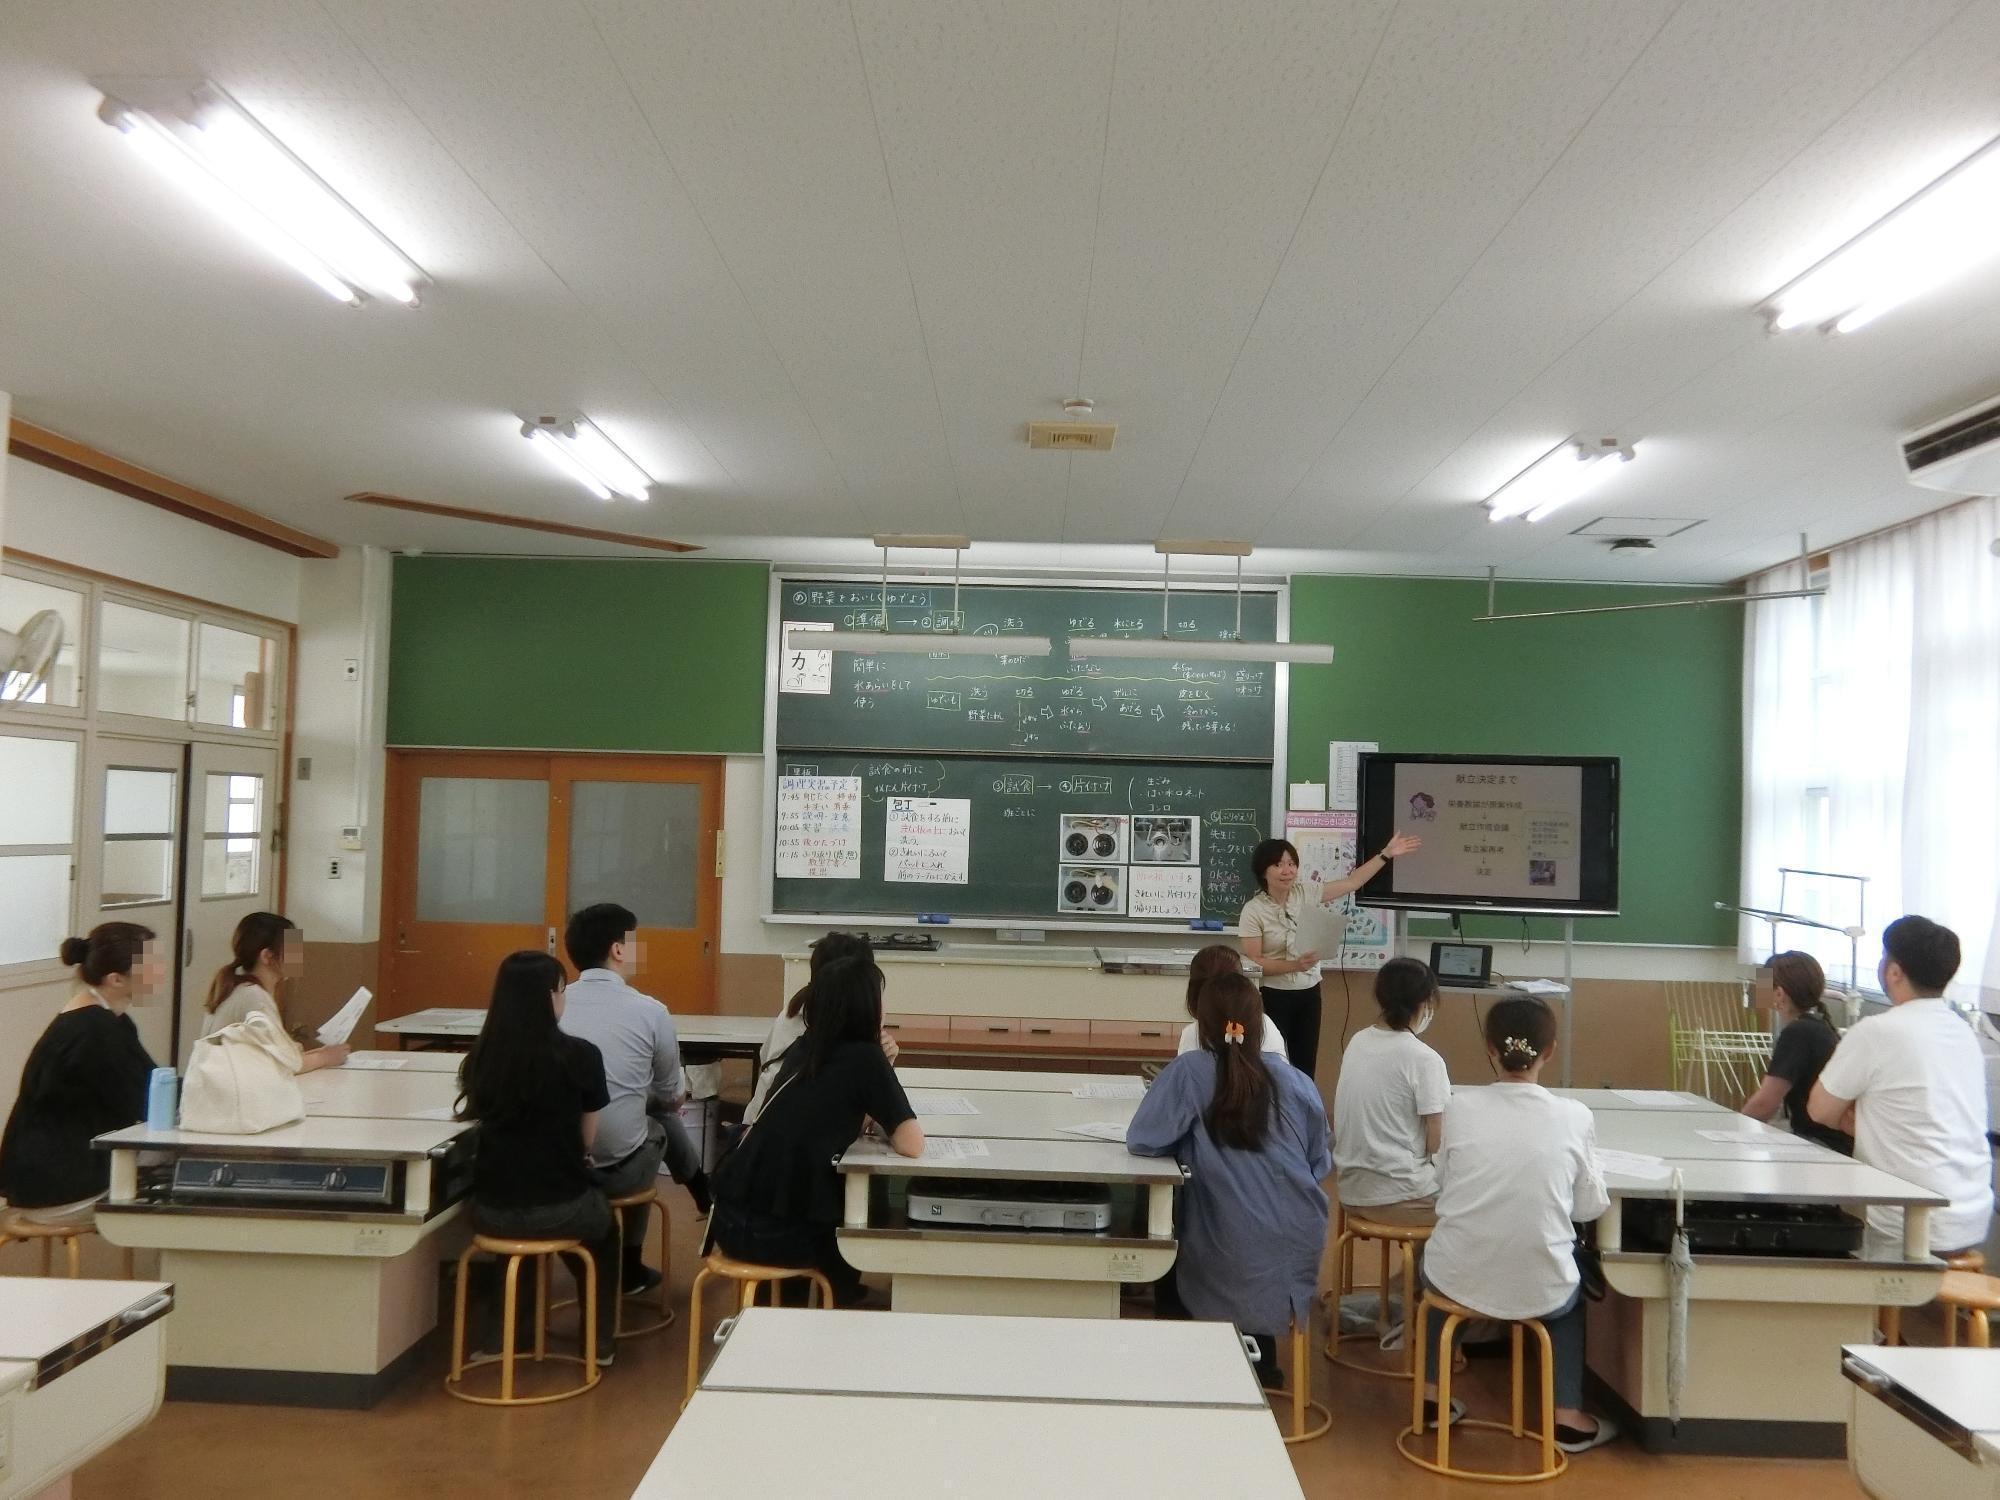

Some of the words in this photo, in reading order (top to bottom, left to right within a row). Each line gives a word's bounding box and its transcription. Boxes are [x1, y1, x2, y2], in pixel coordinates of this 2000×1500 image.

[811, 591, 926, 606] 野菜をおいしくゆでよう
[1070, 618, 1095, 628] ゆでる
[853, 658, 888, 673] 簡単に
[1061, 686, 1083, 696] ゆでる
[869, 763, 923, 776] 試食の前に
[893, 799, 912, 810] 包丁
